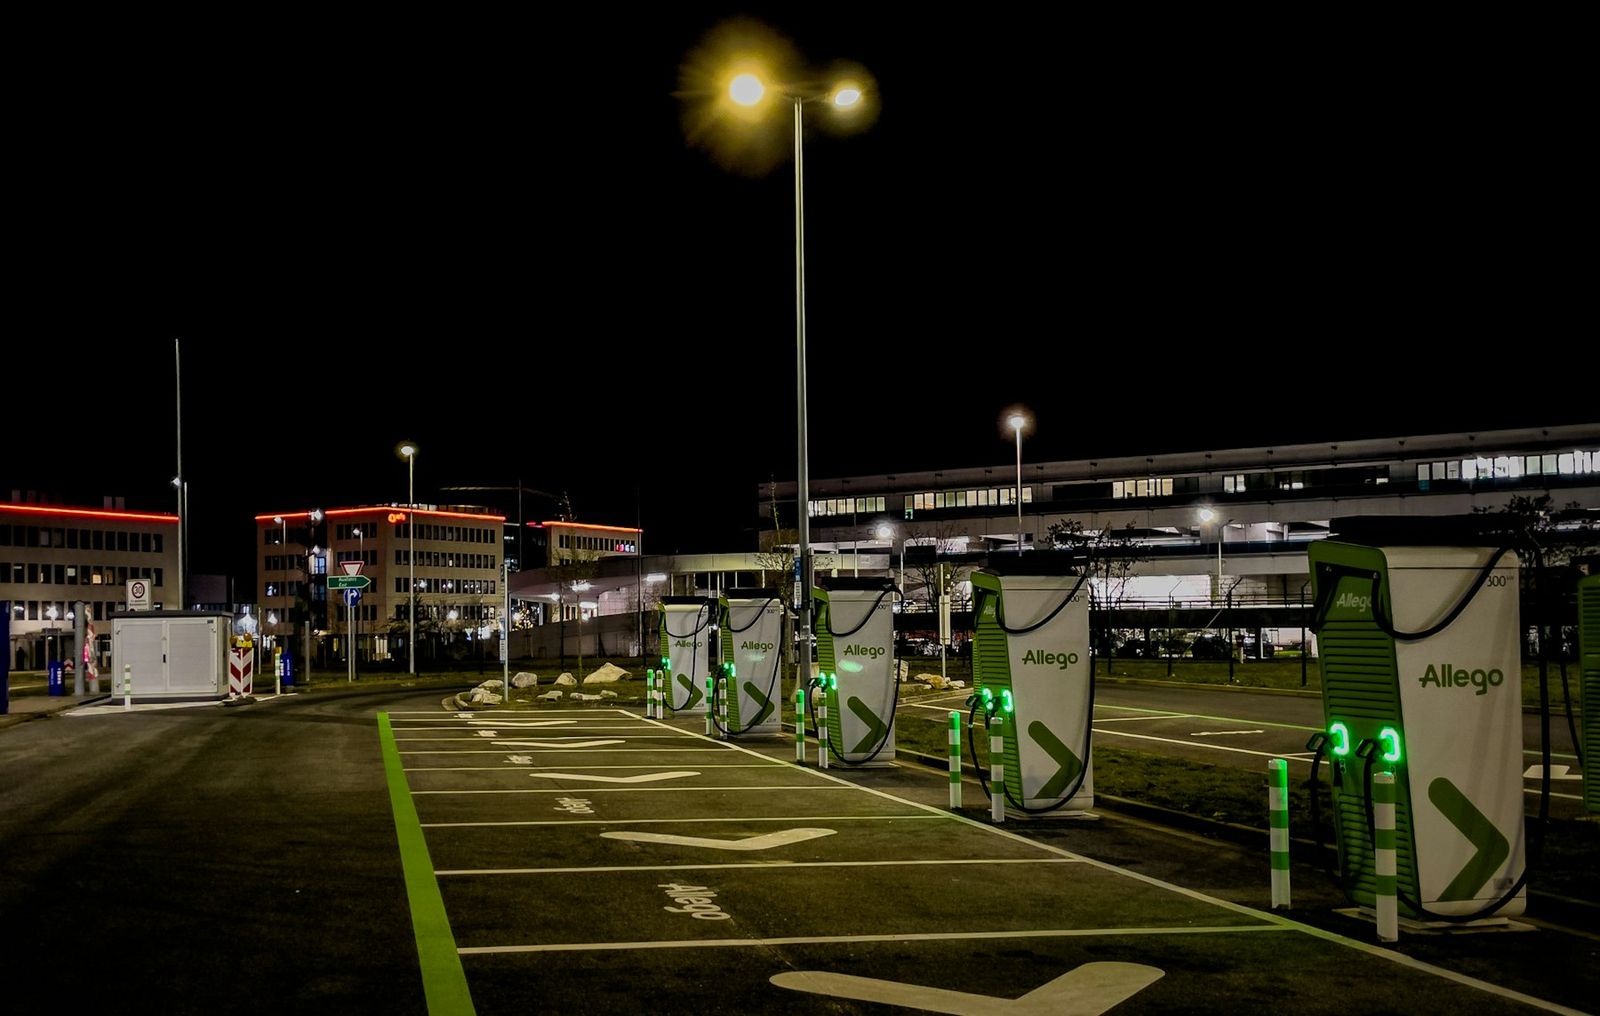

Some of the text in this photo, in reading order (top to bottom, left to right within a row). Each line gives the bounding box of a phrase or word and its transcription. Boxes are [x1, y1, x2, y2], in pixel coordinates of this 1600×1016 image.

[741, 641, 774, 653] Allego
[843, 644, 885, 660] Allego
[1021, 649, 1078, 670] Allego
[1418, 663, 1504, 696] Allego
[657, 883, 731, 920] Allego
